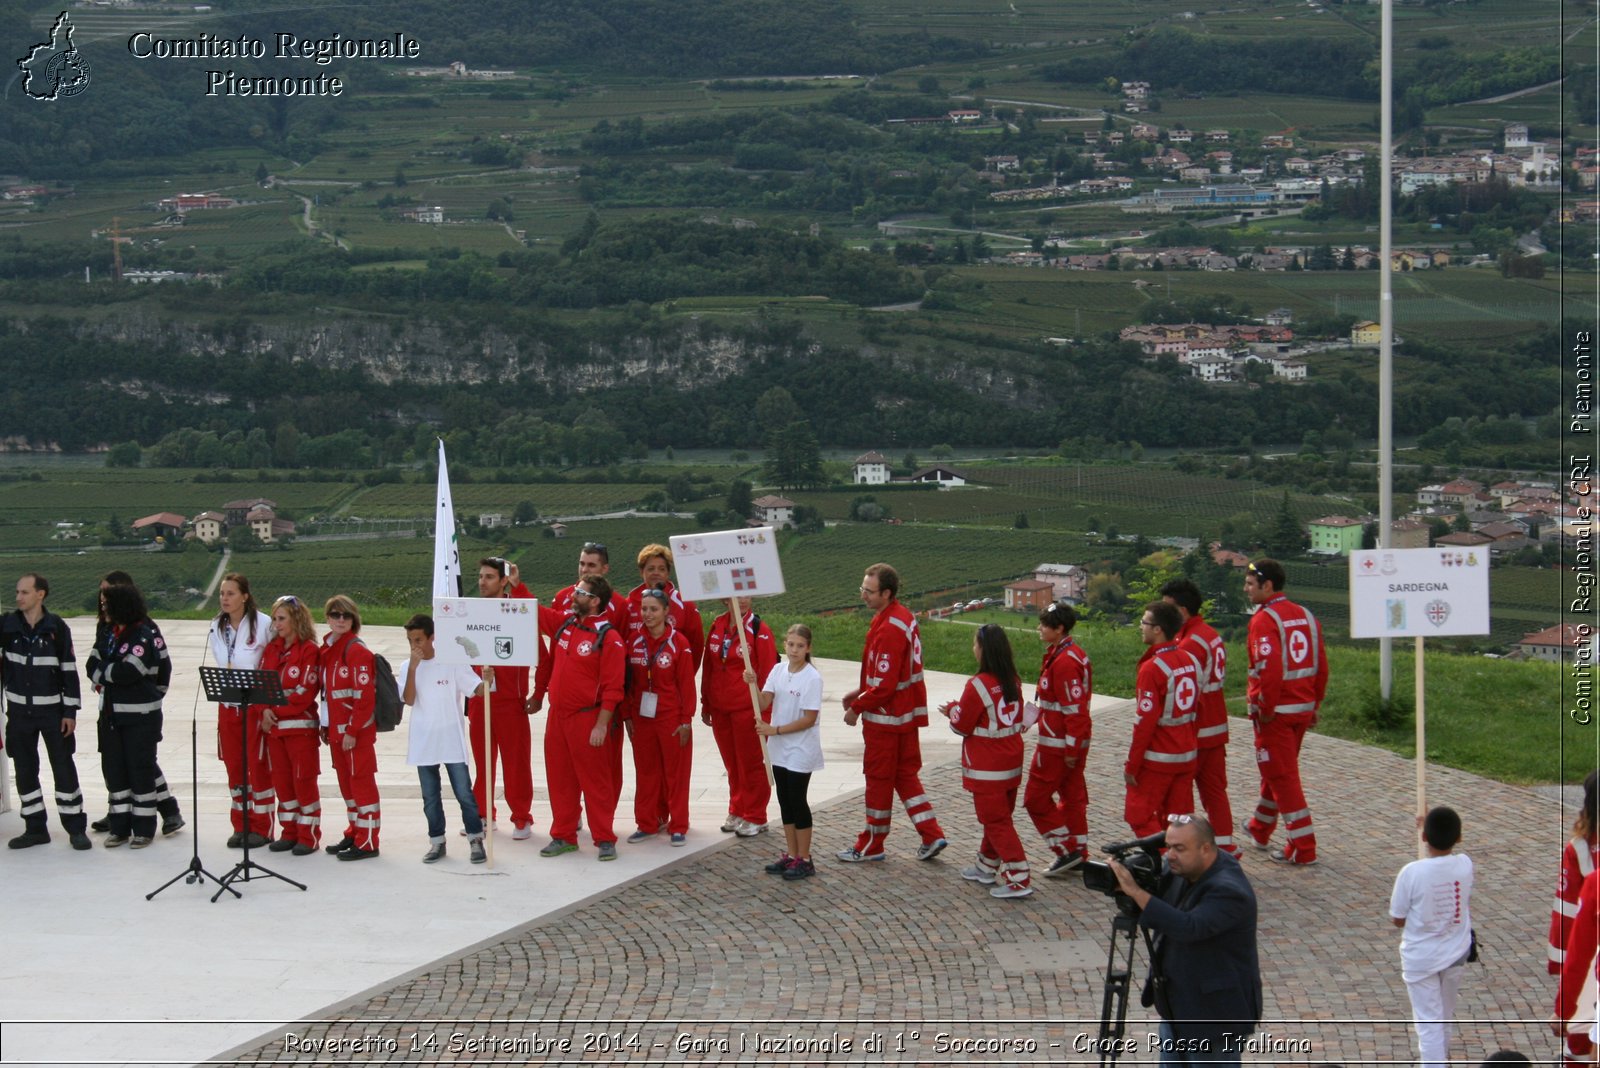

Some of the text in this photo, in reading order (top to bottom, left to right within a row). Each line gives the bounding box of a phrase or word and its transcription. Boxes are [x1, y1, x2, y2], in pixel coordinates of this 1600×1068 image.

[703, 556, 745, 567] PIEMONTE
[1388, 582, 1449, 593] SARDEGNA
[466, 624, 502, 632] MARCHE
